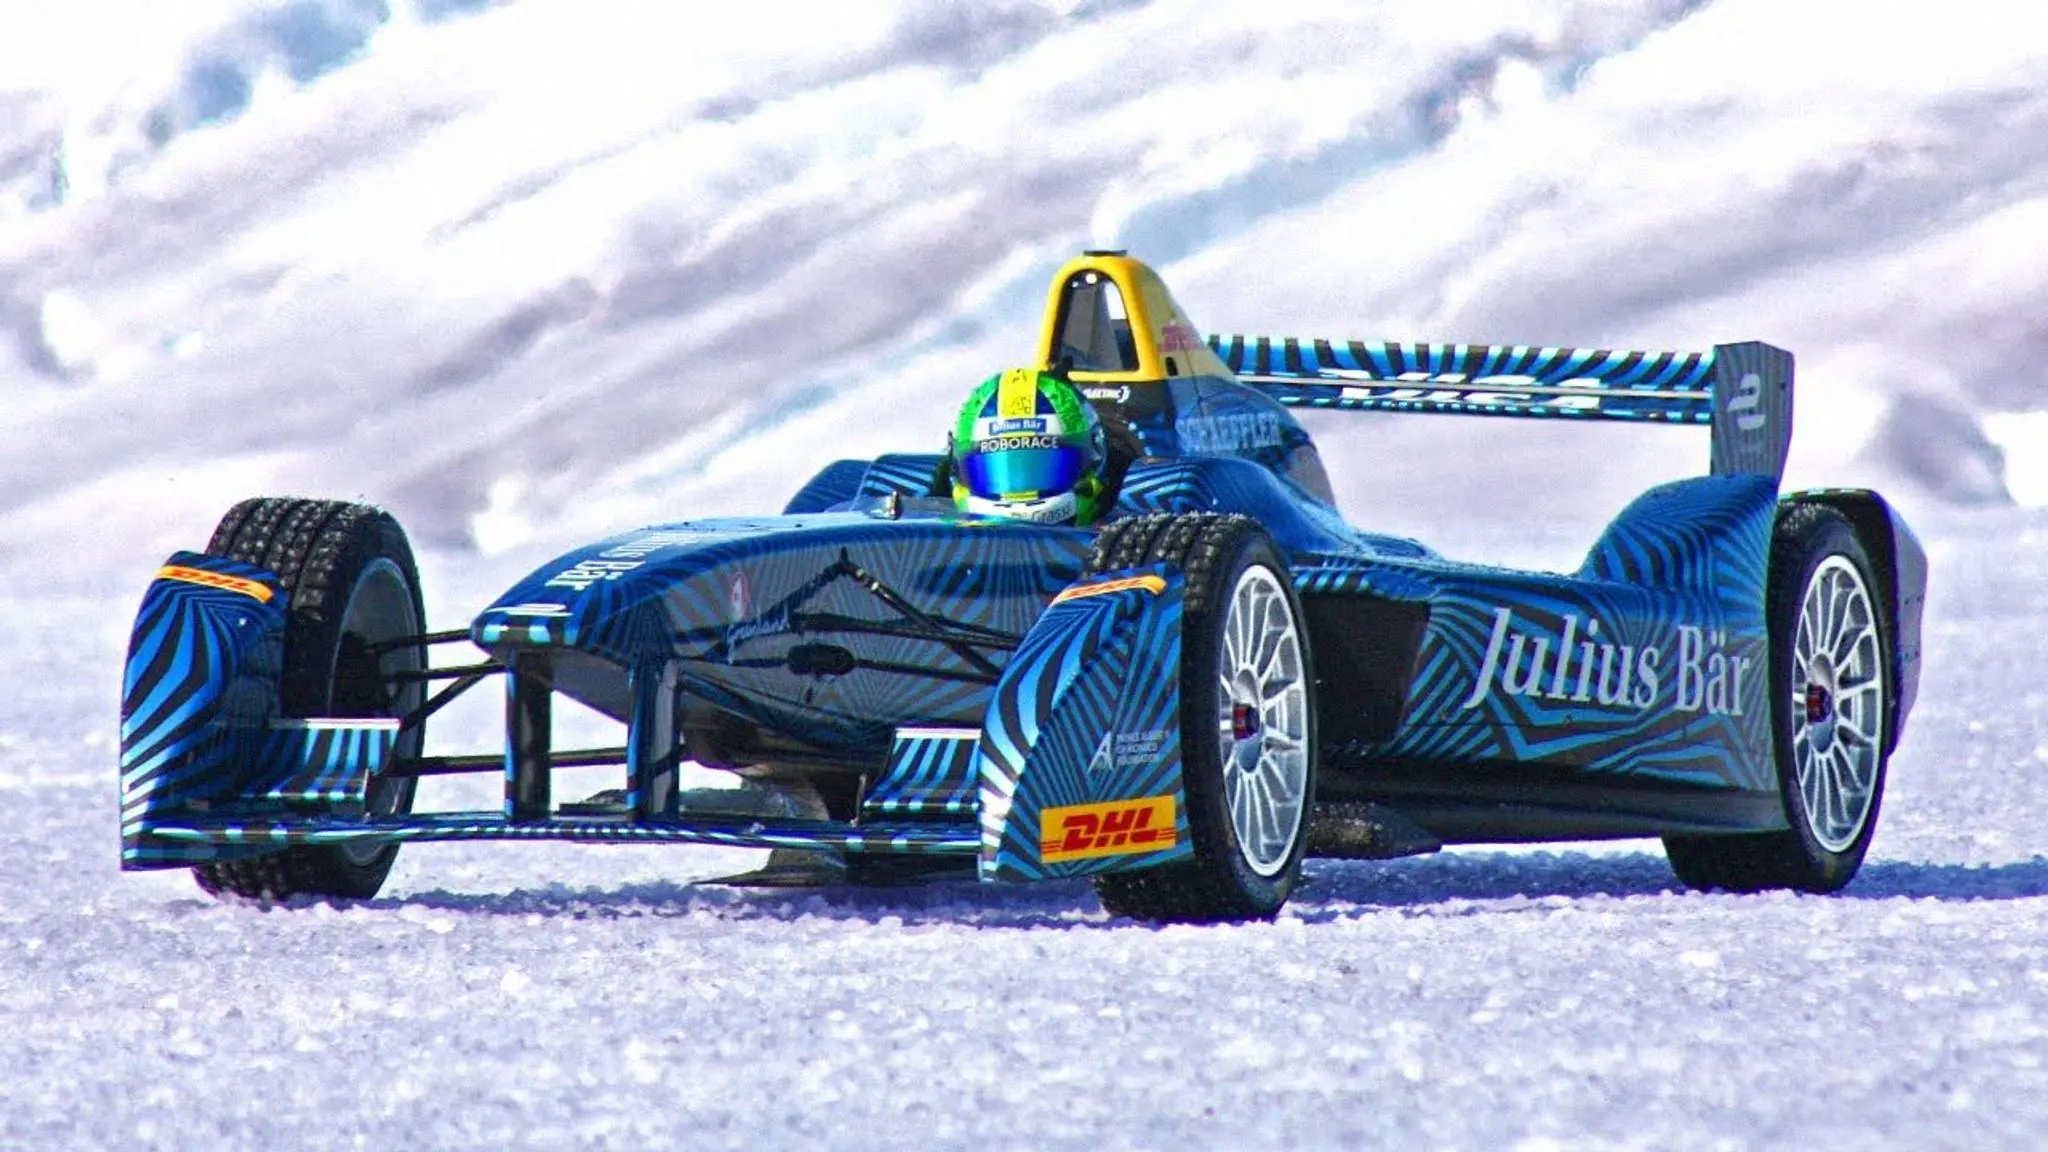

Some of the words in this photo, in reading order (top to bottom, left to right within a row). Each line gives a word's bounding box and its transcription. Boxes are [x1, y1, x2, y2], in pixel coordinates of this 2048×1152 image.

[980, 436, 1060, 453] ROBORACE
[1463, 607, 1659, 709] Julius
[1673, 624, 1750, 716] Bär
[1061, 806, 1158, 851] DHL
